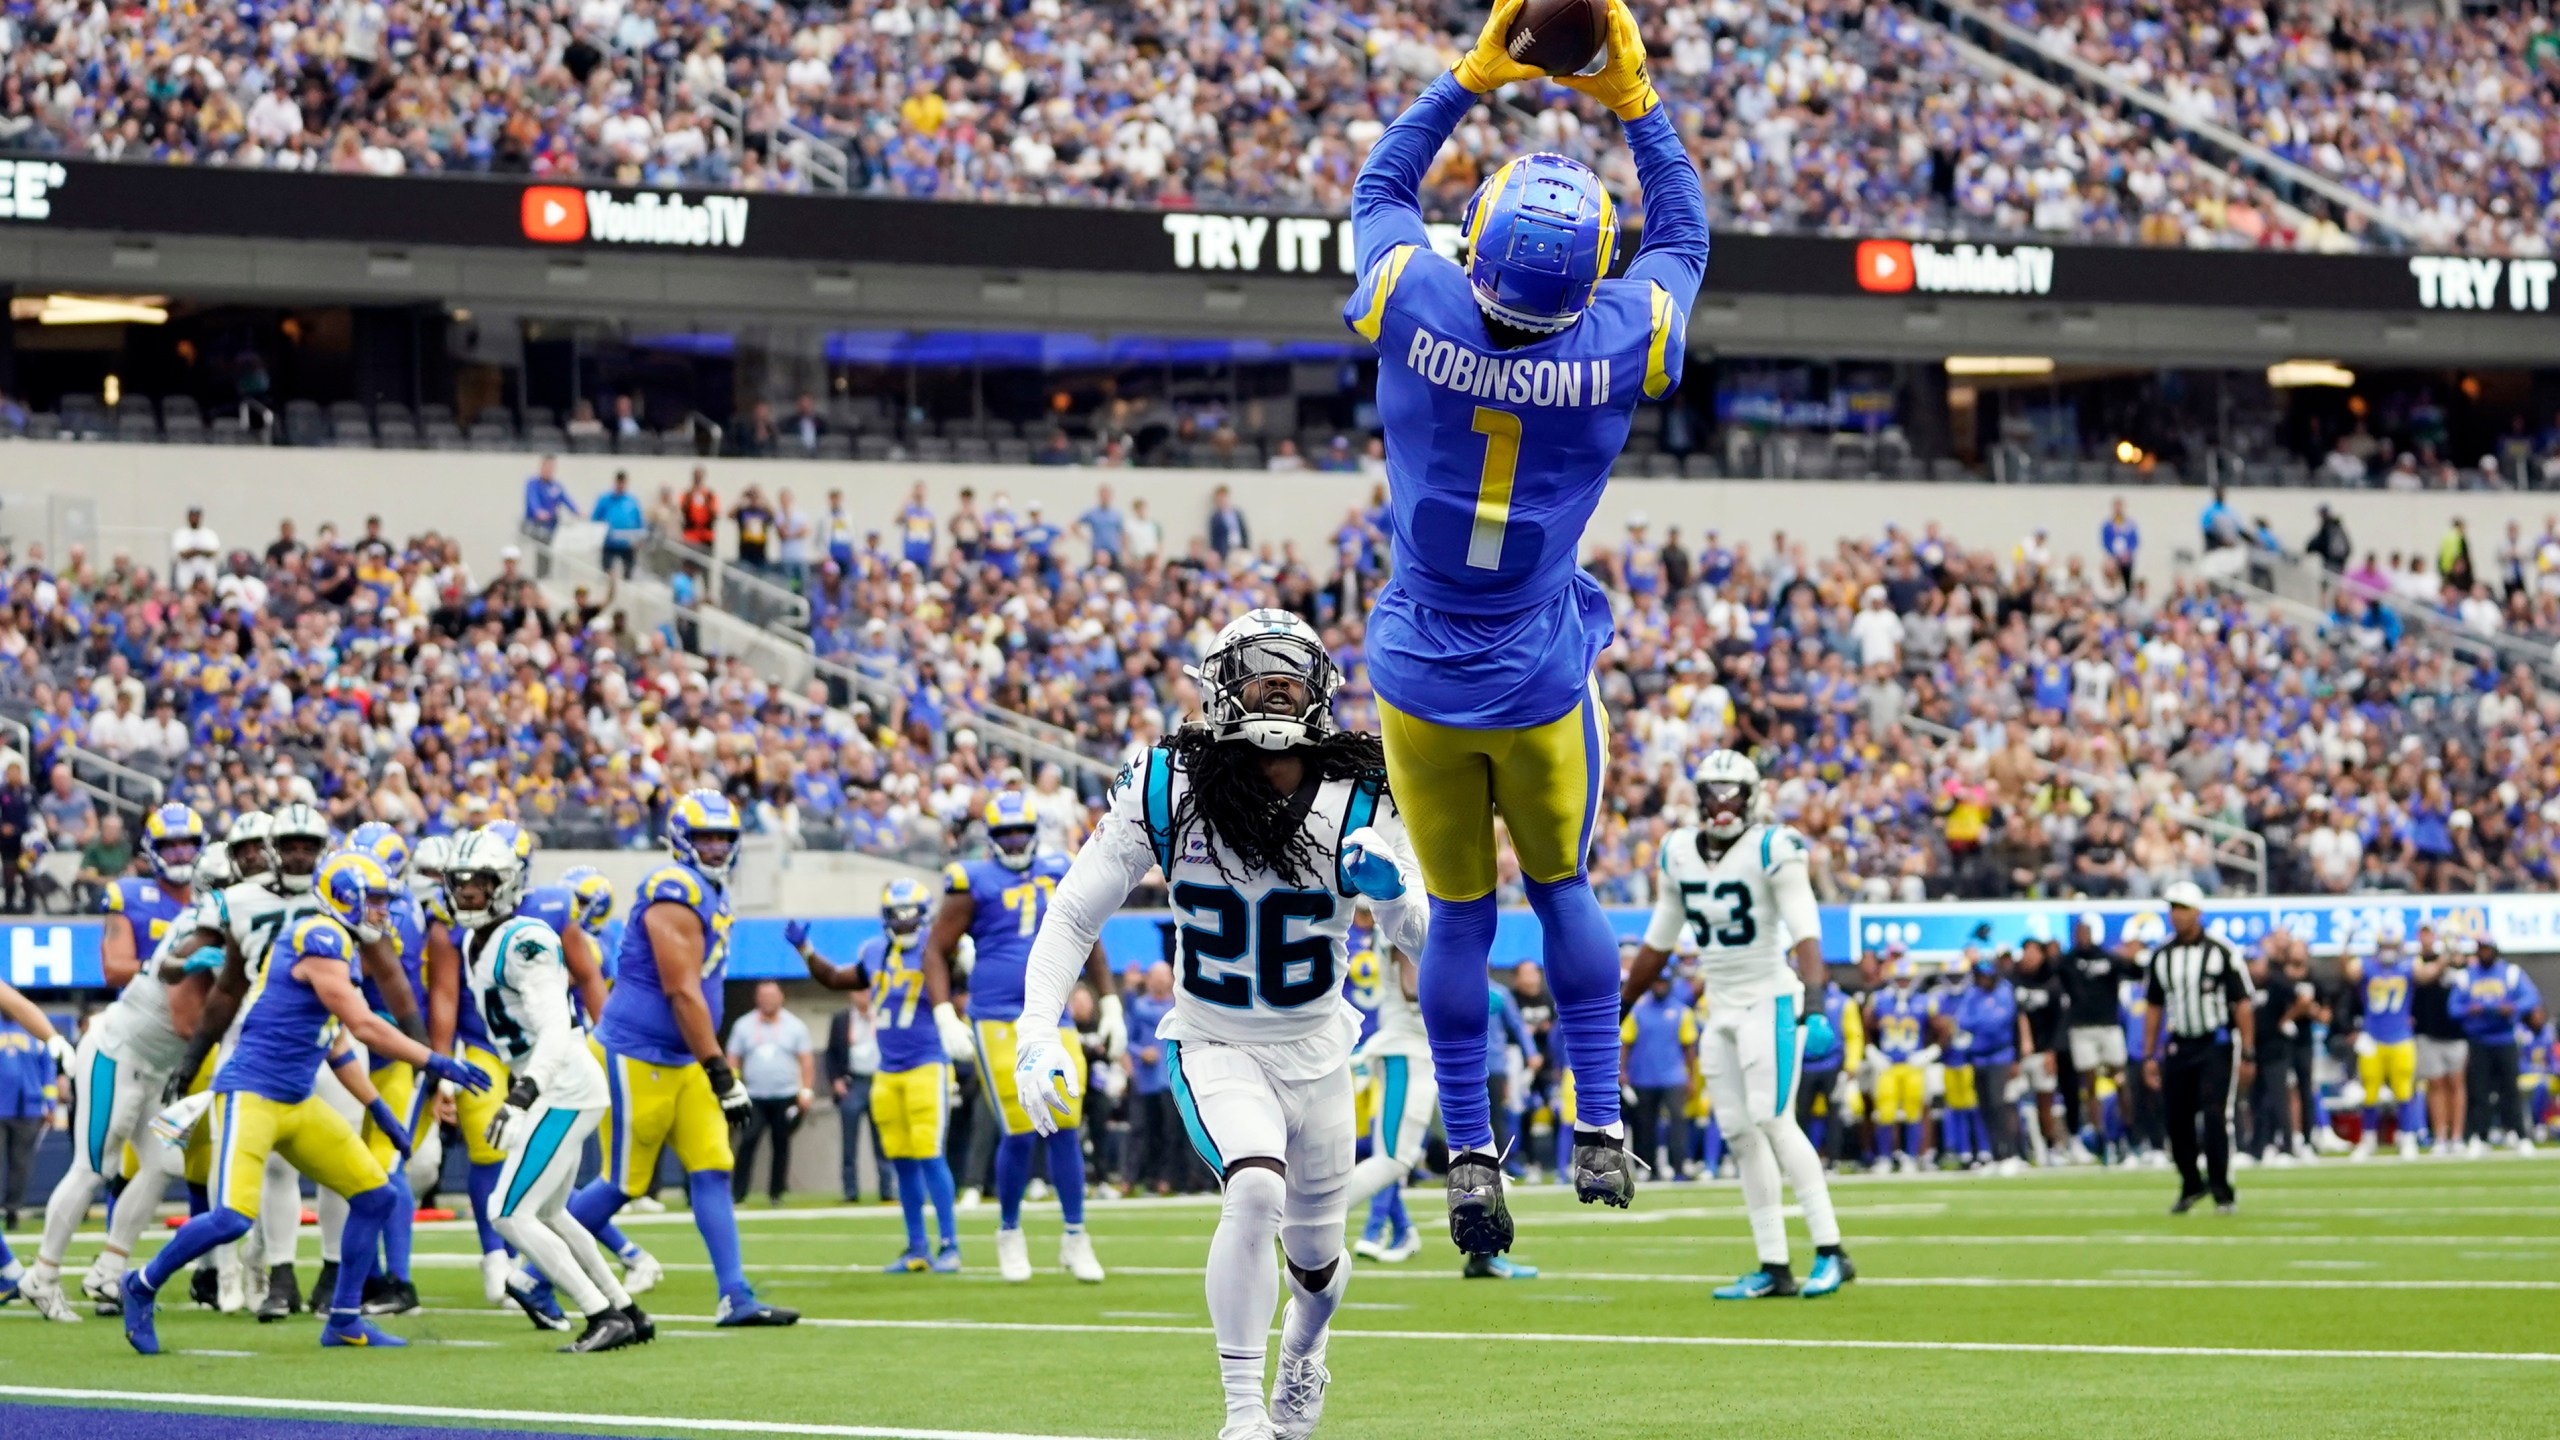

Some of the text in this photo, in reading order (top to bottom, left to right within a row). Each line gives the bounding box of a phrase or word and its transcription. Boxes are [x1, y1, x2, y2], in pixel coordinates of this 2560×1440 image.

[1163, 213, 1269, 270] TRY
[1276, 217, 1331, 272] IT
[2409, 255, 2557, 311] TRY IT
[1407, 327, 1581, 407] ROBINSON
[1466, 405, 1523, 571] 1
[1173, 880, 1336, 1009] 26
[1680, 881, 1756, 947] 53
[11, 926, 73, 987] H
